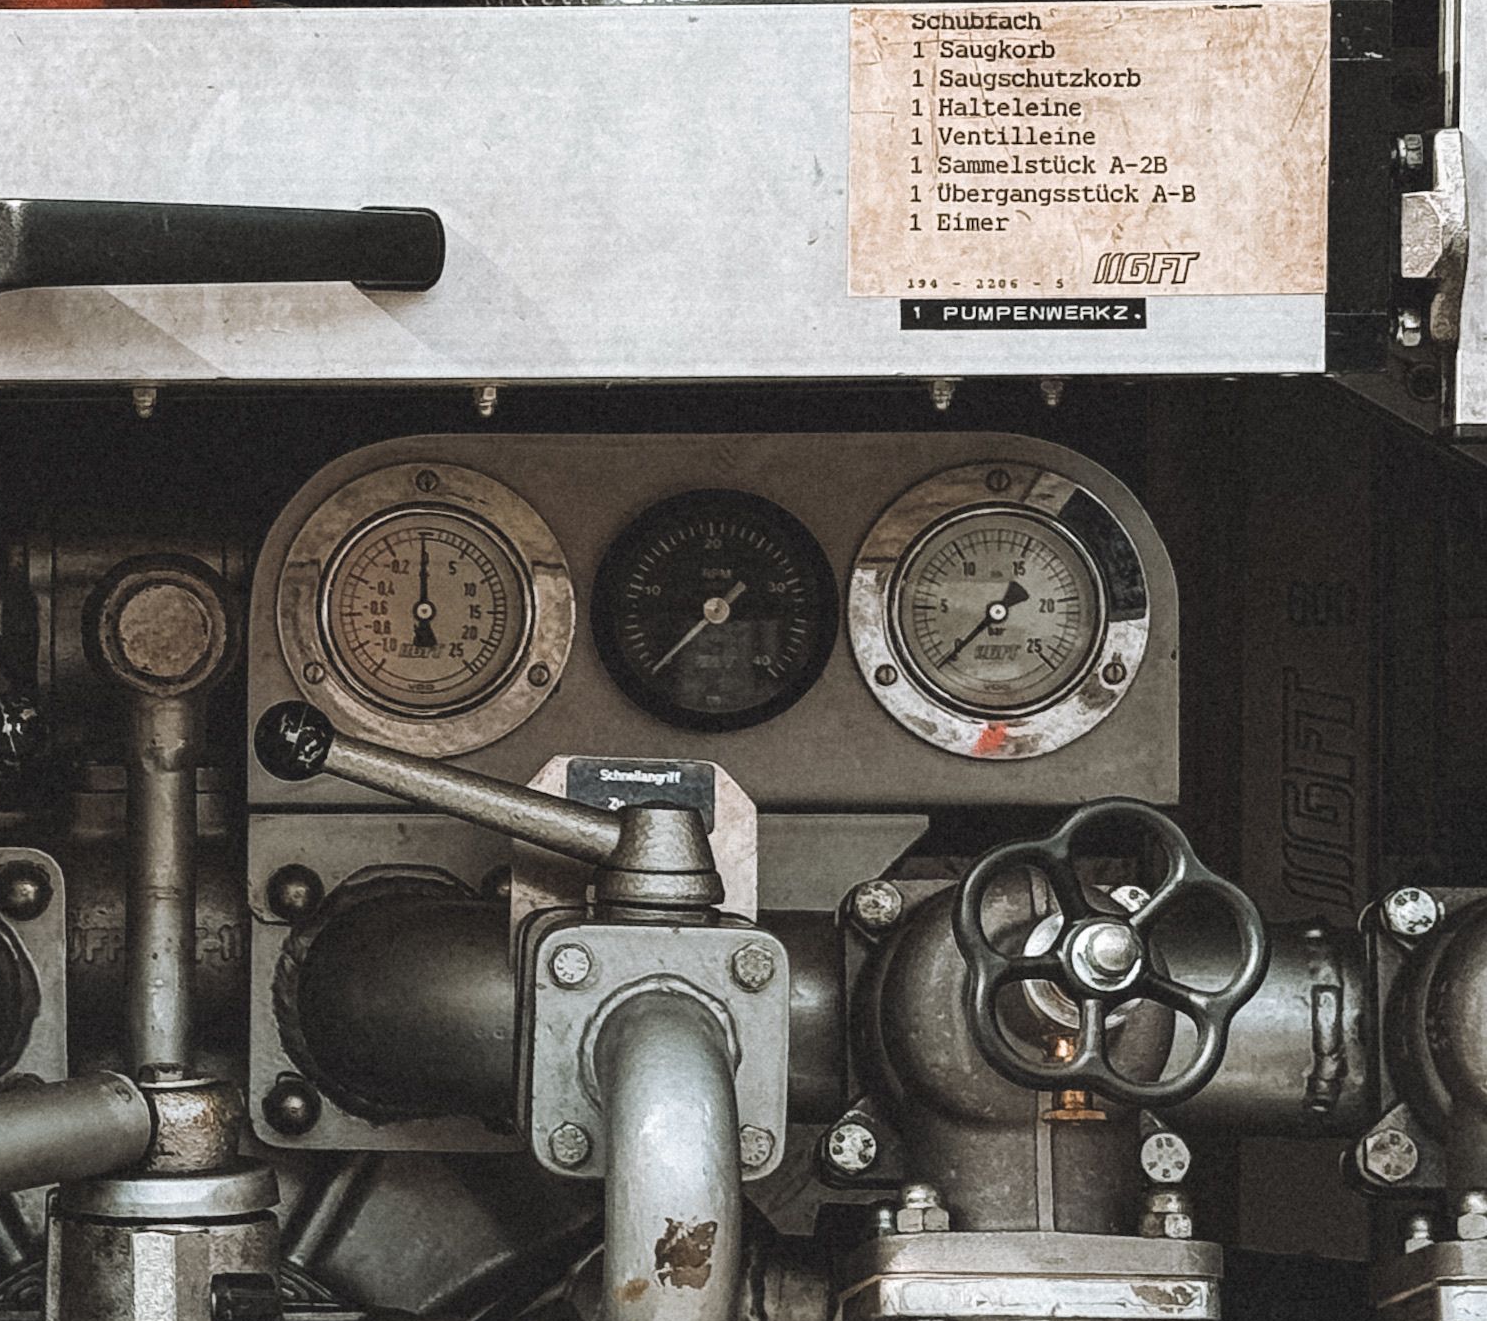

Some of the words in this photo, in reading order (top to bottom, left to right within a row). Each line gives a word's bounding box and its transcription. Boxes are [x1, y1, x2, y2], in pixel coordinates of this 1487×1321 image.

[912, 12, 1042, 31] Schubfach
[912, 41, 923, 58] 1
[939, 40, 1056, 64] Saugkorb
[912, 70, 923, 87] 1
[938, 69, 1141, 92] Saugschutzkorb
[912, 99, 923, 116] 1
[938, 99, 1082, 118] Halteleine
[911, 128, 922, 145] 1
[937, 127, 1097, 146] Ventilleine
[911, 157, 922, 174] 1
[937, 155, 1097, 175] Sammelstück
[1110, 157, 1168, 175] A-2B
[910, 186, 921, 203] 1
[937, 183, 1139, 207] Übergangsstück
[1151, 185, 1196, 204] A-B
[910, 215, 921, 232] 1
[937, 213, 1011, 232] Eimer
[907, 279, 939, 290] 194
[913, 307, 921, 321] 1
[943, 304, 1143, 322] PUMPENWERKZ.
[448, 560, 458, 575] 5
[963, 561, 976, 576] 10
[1013, 561, 1026, 576] 15
[463, 582, 477, 597] 10
[469, 604, 482, 619] 15
[940, 599, 948, 613] 5
[1039, 599, 1055, 613] 20
[462, 624, 478, 640] 20
[449, 642, 464, 658] 25
[1027, 637, 1042, 654] 25
[599, 768, 682, 786] Schnellangriff
